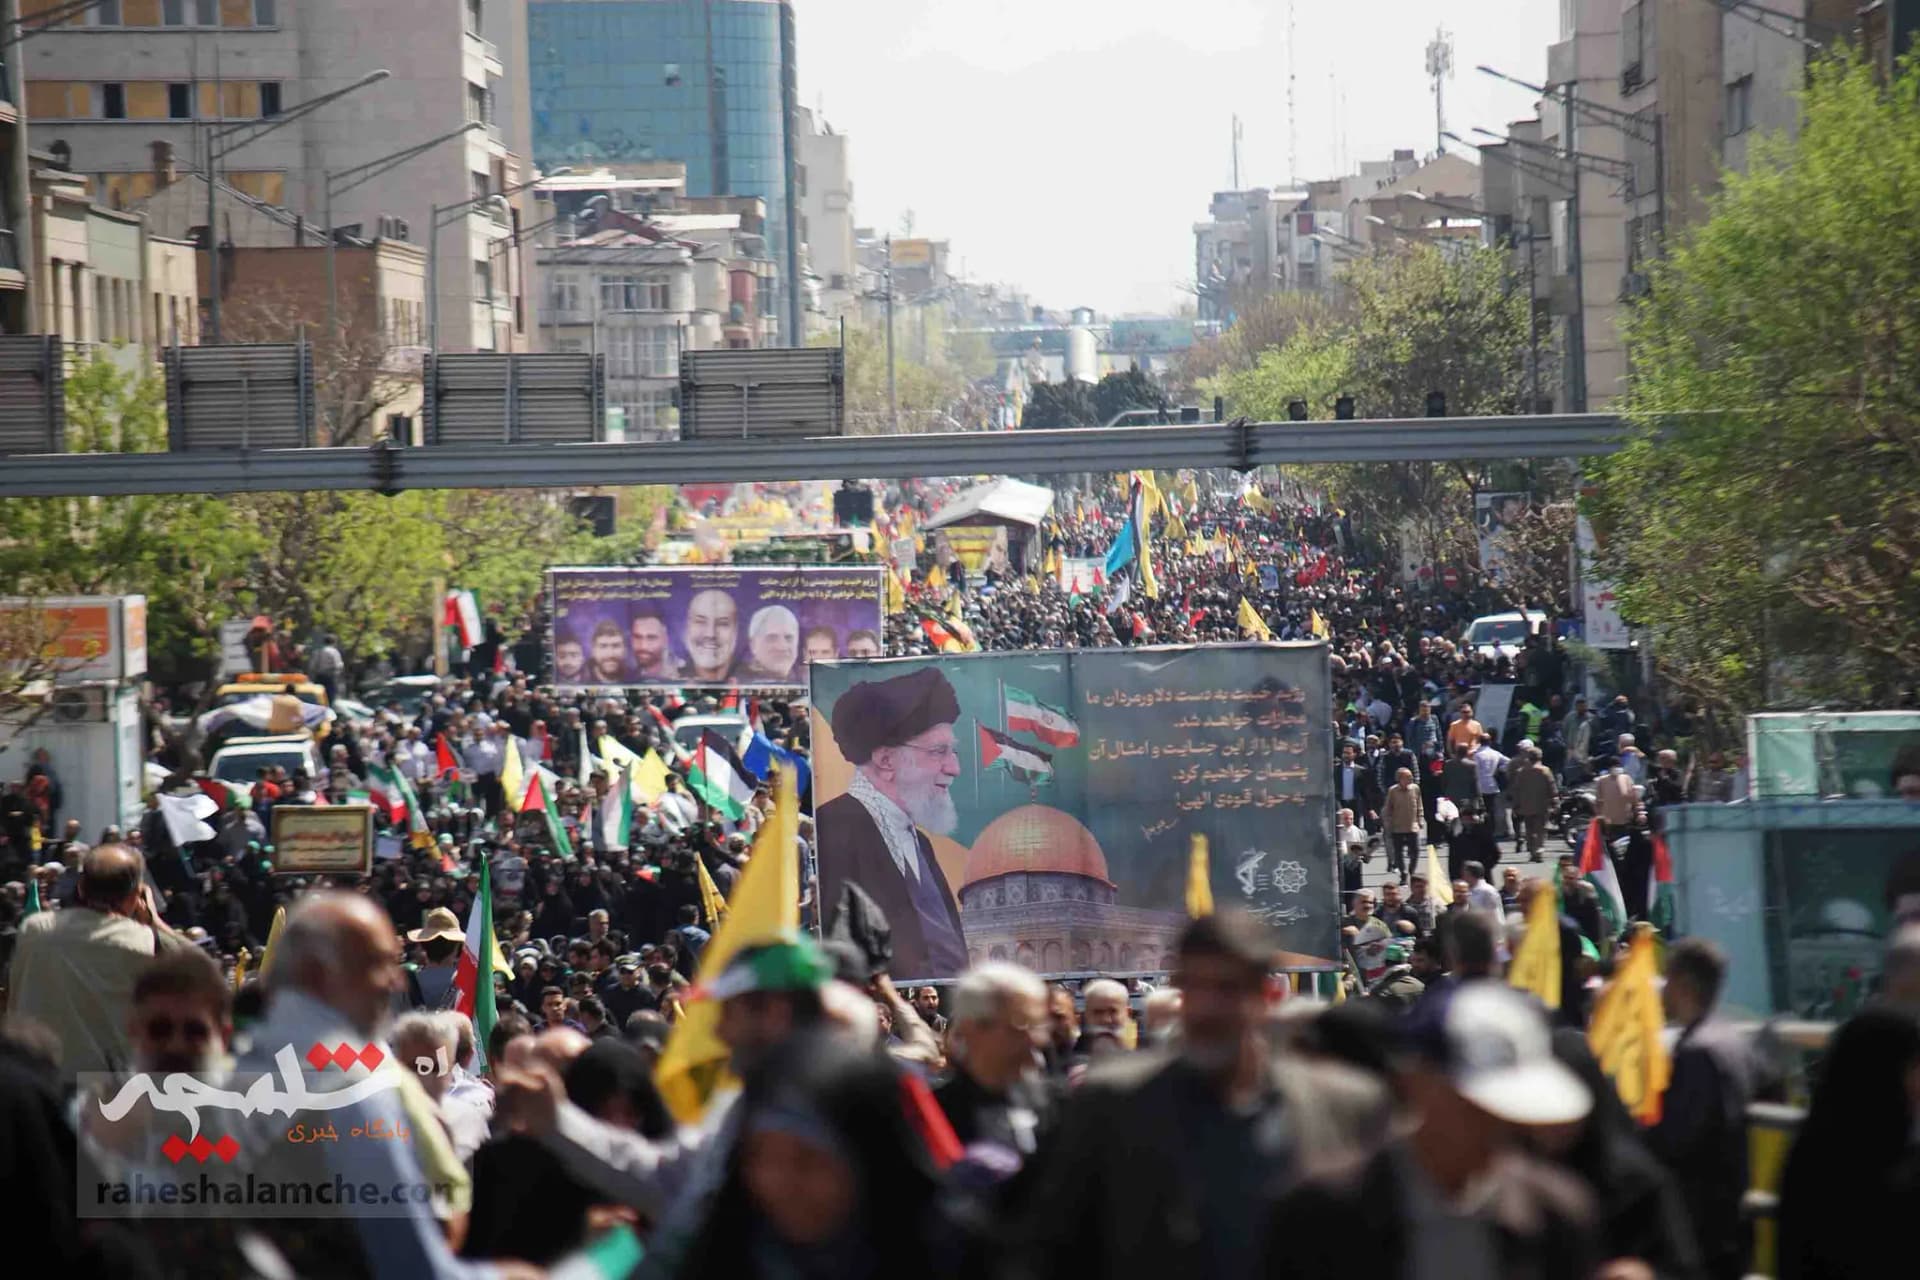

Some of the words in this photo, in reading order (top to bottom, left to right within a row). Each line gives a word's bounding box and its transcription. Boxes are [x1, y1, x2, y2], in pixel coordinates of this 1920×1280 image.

[1085, 688, 1101, 705] ما
[1212, 688, 1230, 704] به
[1087, 737, 1107, 761] آن
[1107, 738, 1151, 761] امثال
[1150, 744, 1161, 759] و
[1161, 739, 1218, 758] جنایت
[1220, 737, 1246, 757] این
[1254, 762, 1309, 784] پشیمان
